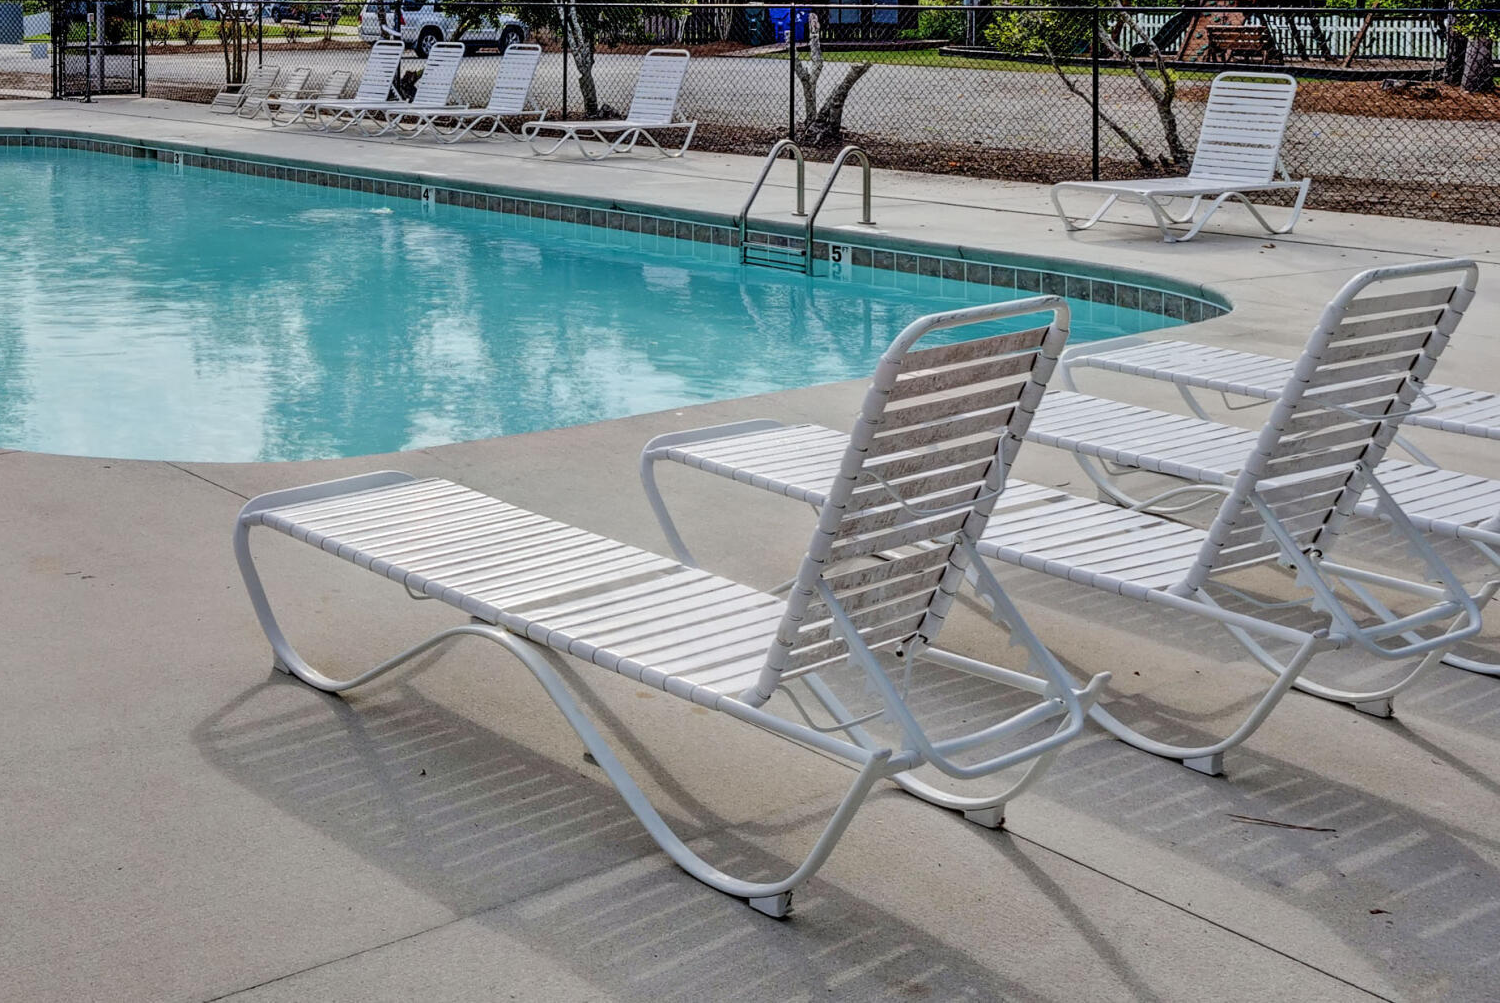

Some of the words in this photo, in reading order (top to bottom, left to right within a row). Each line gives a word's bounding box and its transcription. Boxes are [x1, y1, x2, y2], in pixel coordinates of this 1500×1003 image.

[175, 153, 180, 164] 3
[423, 188, 430, 201] 4
[832, 245, 842, 262] 5
